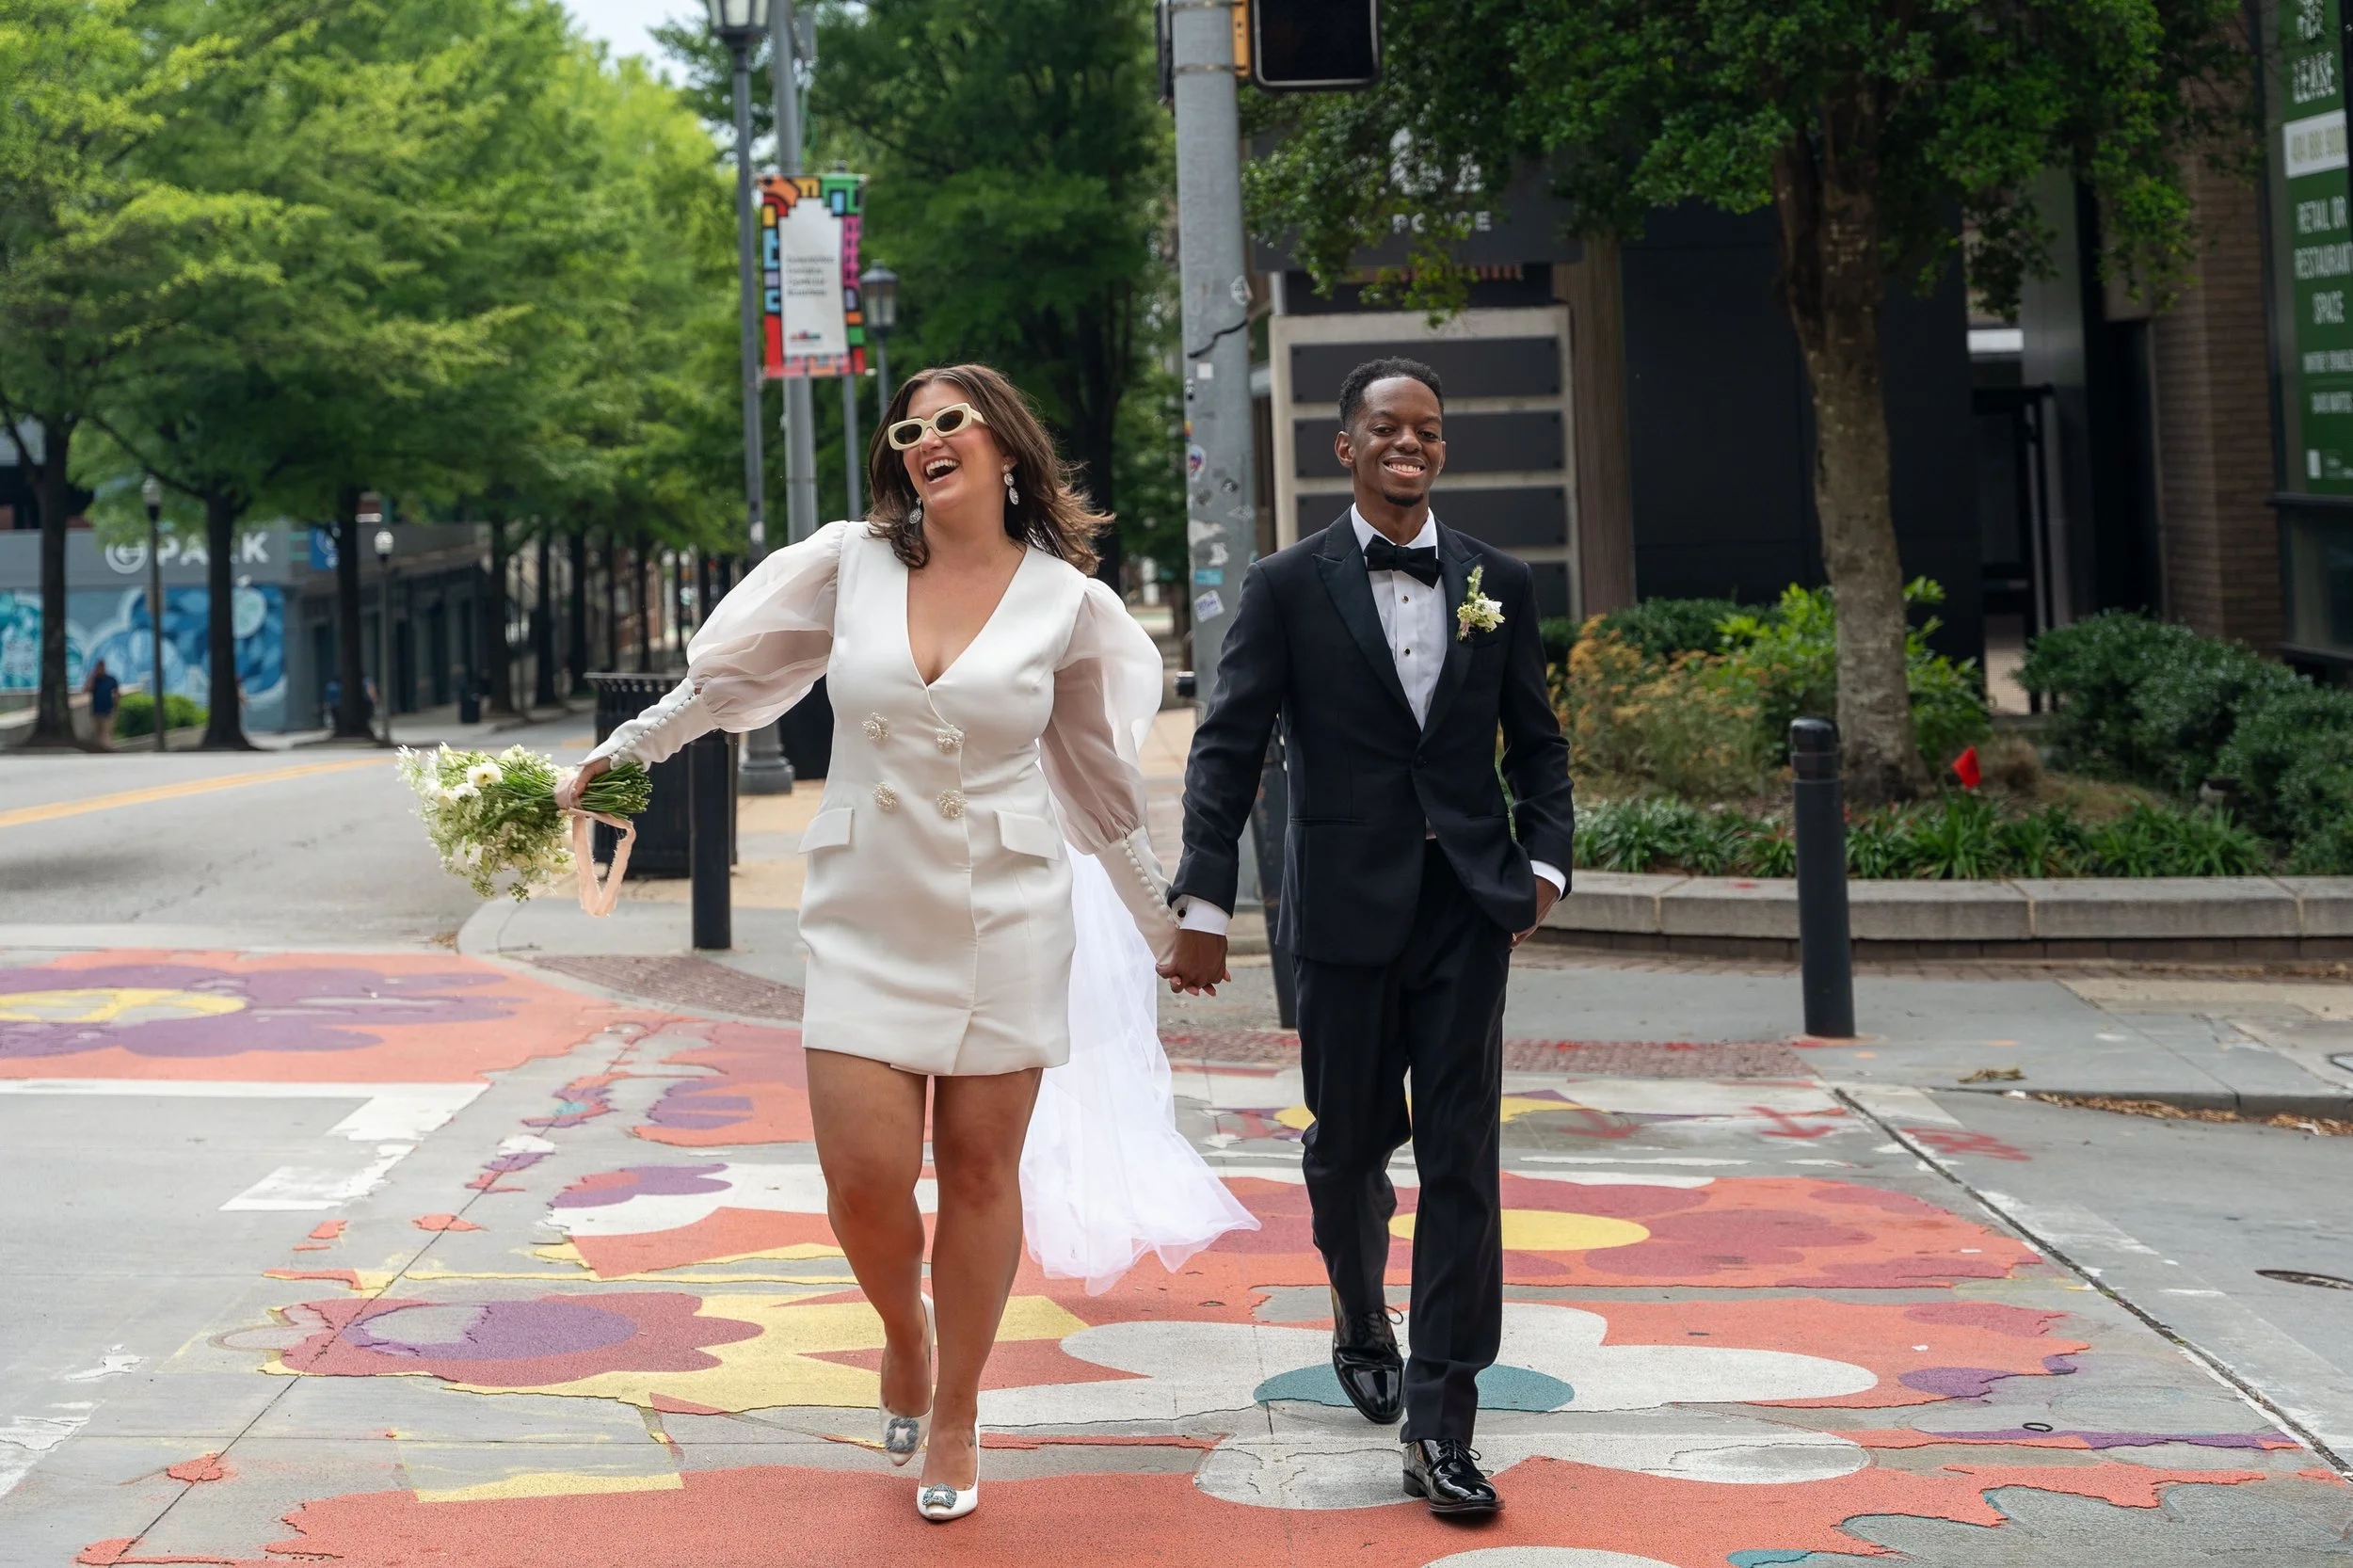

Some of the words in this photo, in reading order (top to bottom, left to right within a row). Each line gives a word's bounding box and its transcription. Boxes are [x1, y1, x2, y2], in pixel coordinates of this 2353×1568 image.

[2291, 51, 2337, 104] LEASE
[2297, 198, 2331, 233] RETAIL
[2330, 195, 2348, 229] OR
[2312, 290, 2346, 325] SPACE
[156, 531, 271, 567] PAK
